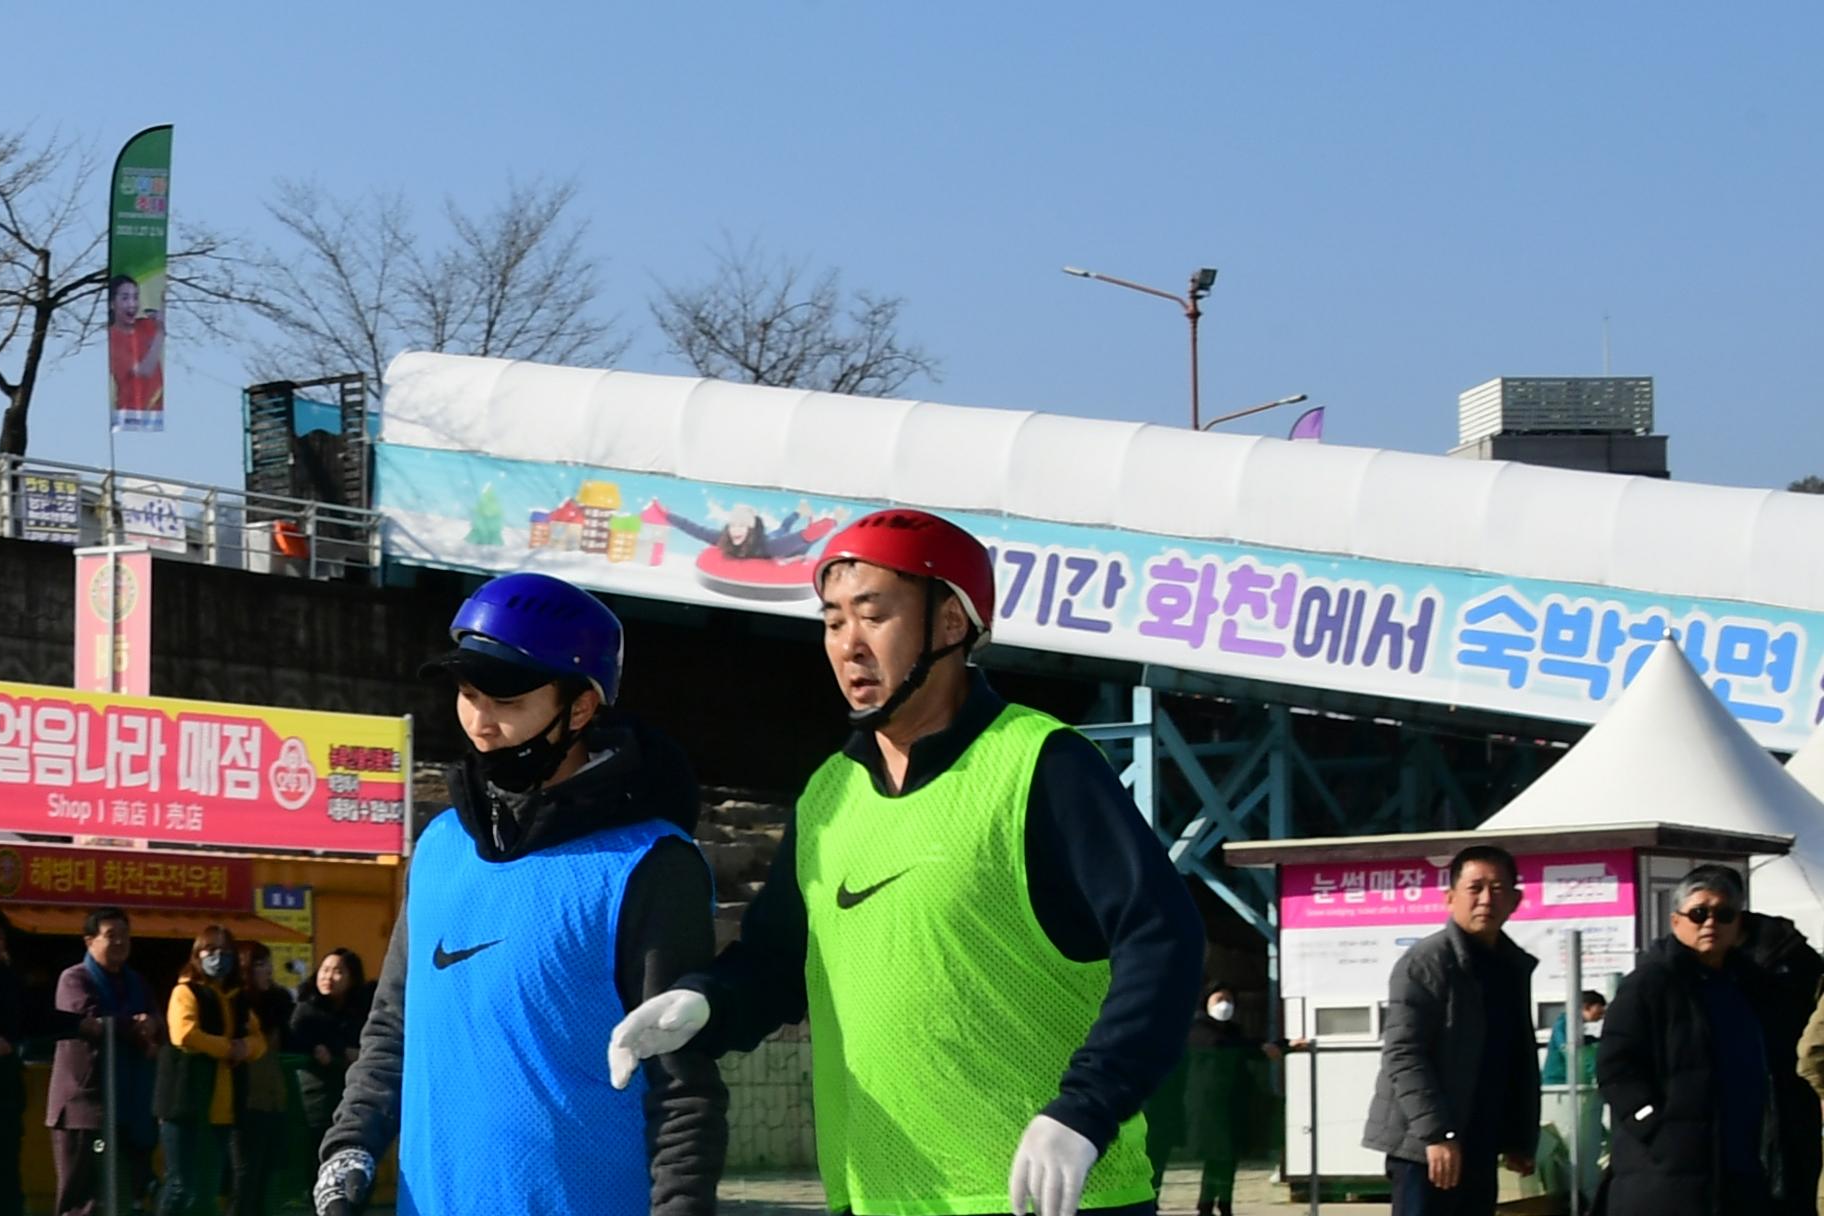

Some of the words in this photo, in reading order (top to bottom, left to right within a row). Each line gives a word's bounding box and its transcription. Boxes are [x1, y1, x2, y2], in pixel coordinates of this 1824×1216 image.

[989, 545, 1127, 634] 기간
[1138, 556, 1436, 675] 화천에서
[1456, 594, 1799, 724] 숙박하면
[177, 719, 263, 800] 매점
[47, 793, 92, 824] Shop
[111, 799, 147, 826] 商店
[30, 856, 96, 893] 해병대
[103, 860, 228, 899] 화천군전우회
[1311, 868, 1425, 904] 눈썰매장
